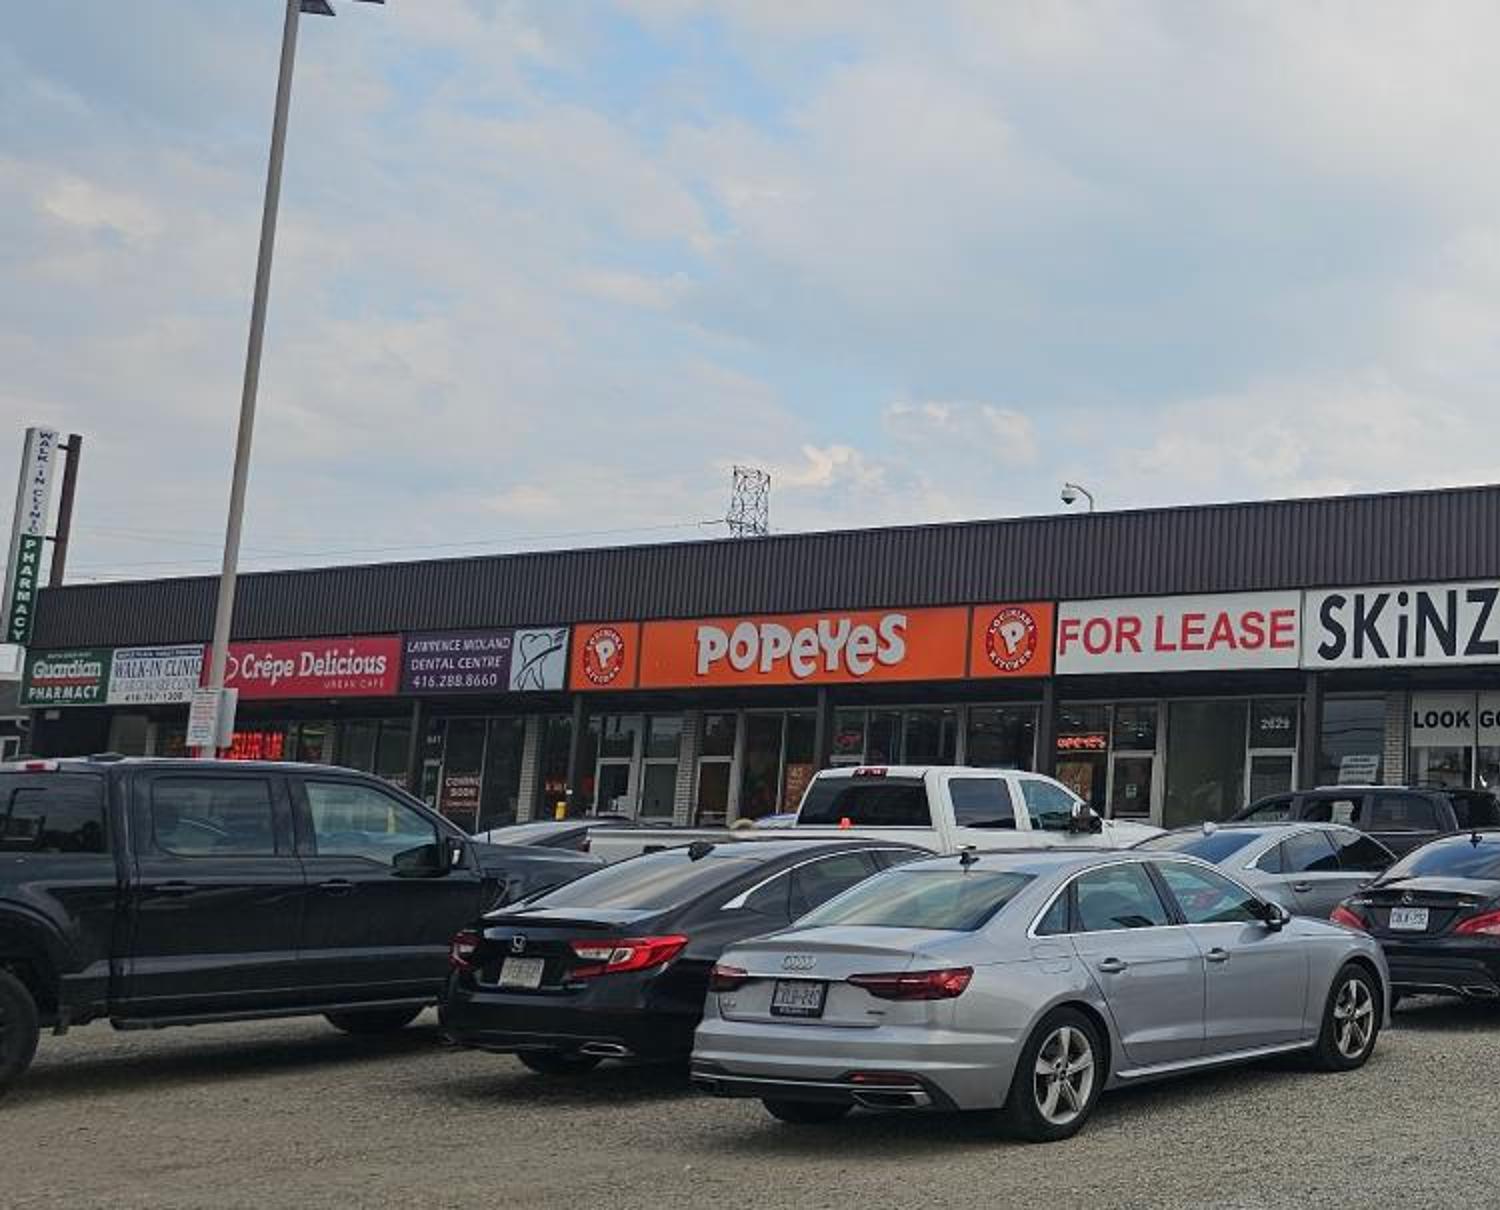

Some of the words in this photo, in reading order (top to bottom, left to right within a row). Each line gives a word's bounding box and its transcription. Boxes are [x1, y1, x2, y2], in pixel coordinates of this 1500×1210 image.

[13, 539, 36, 641] PHARMACY
[1059, 616, 1143, 656] FOR
[1155, 609, 1296, 652] LEASE
[1317, 587, 1500, 661] SKiNZ
[463, 637, 511, 651] MIDLAND
[33, 658, 101, 678] Guardian
[115, 660, 160, 679] WALK-IN
[164, 657, 203, 677] CLINIC
[241, 654, 295, 686] Crêpe
[300, 648, 387, 677] Delicious
[411, 657, 455, 670] DENTAL
[457, 655, 503, 669] CENTRE
[324, 680, 355, 689] URBAN
[412, 673, 497, 688] 416.288.8660
[29, 685, 100, 701] PHARMACY
[1413, 711, 1471, 728] LOOK
